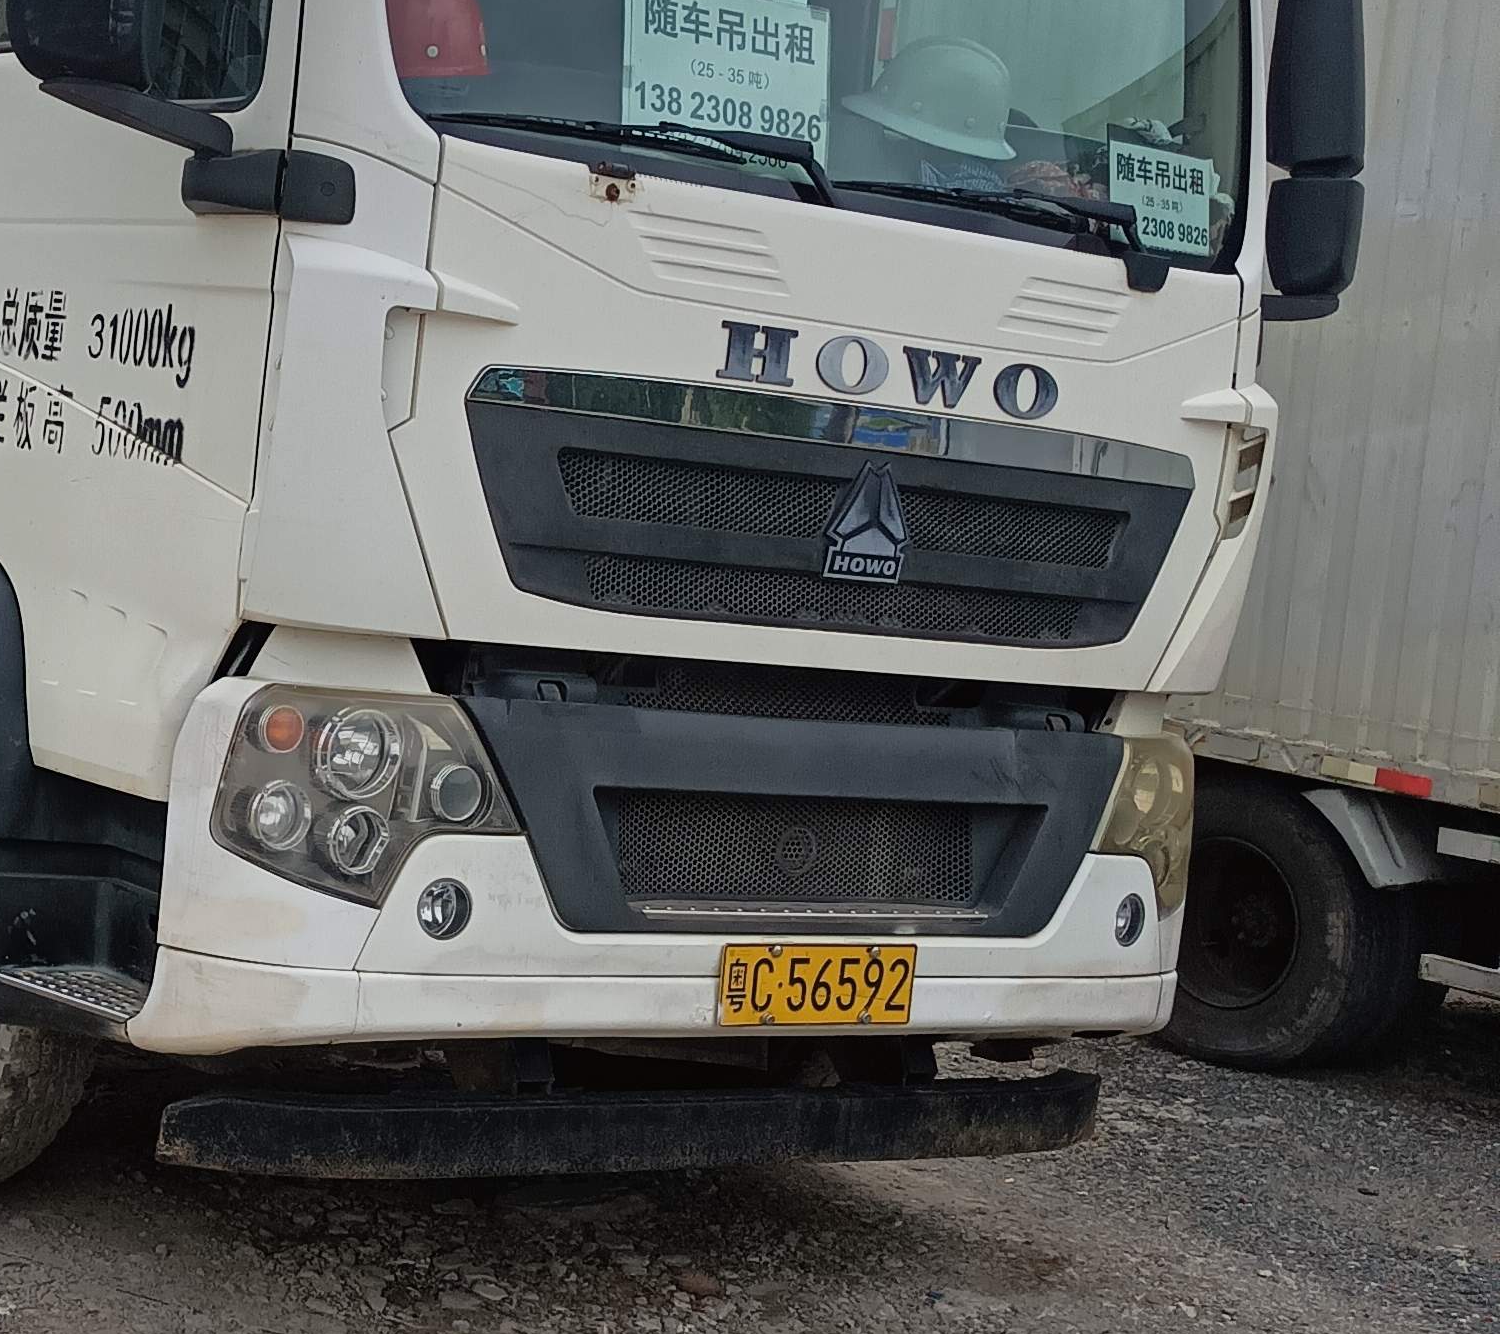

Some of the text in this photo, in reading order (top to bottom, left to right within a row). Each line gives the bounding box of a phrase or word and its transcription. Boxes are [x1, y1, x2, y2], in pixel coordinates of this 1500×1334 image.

[634, 80, 822, 143] 138 2308 9826
[1116, 153, 1205, 196] 随车吊出租
[1141, 216, 1209, 247] 2308 9826
[88, 303, 196, 389] 31000kg
[715, 319, 1059, 420] HOWO
[91, 395, 185, 467] 500mm
[833, 554, 898, 578] HOWO
